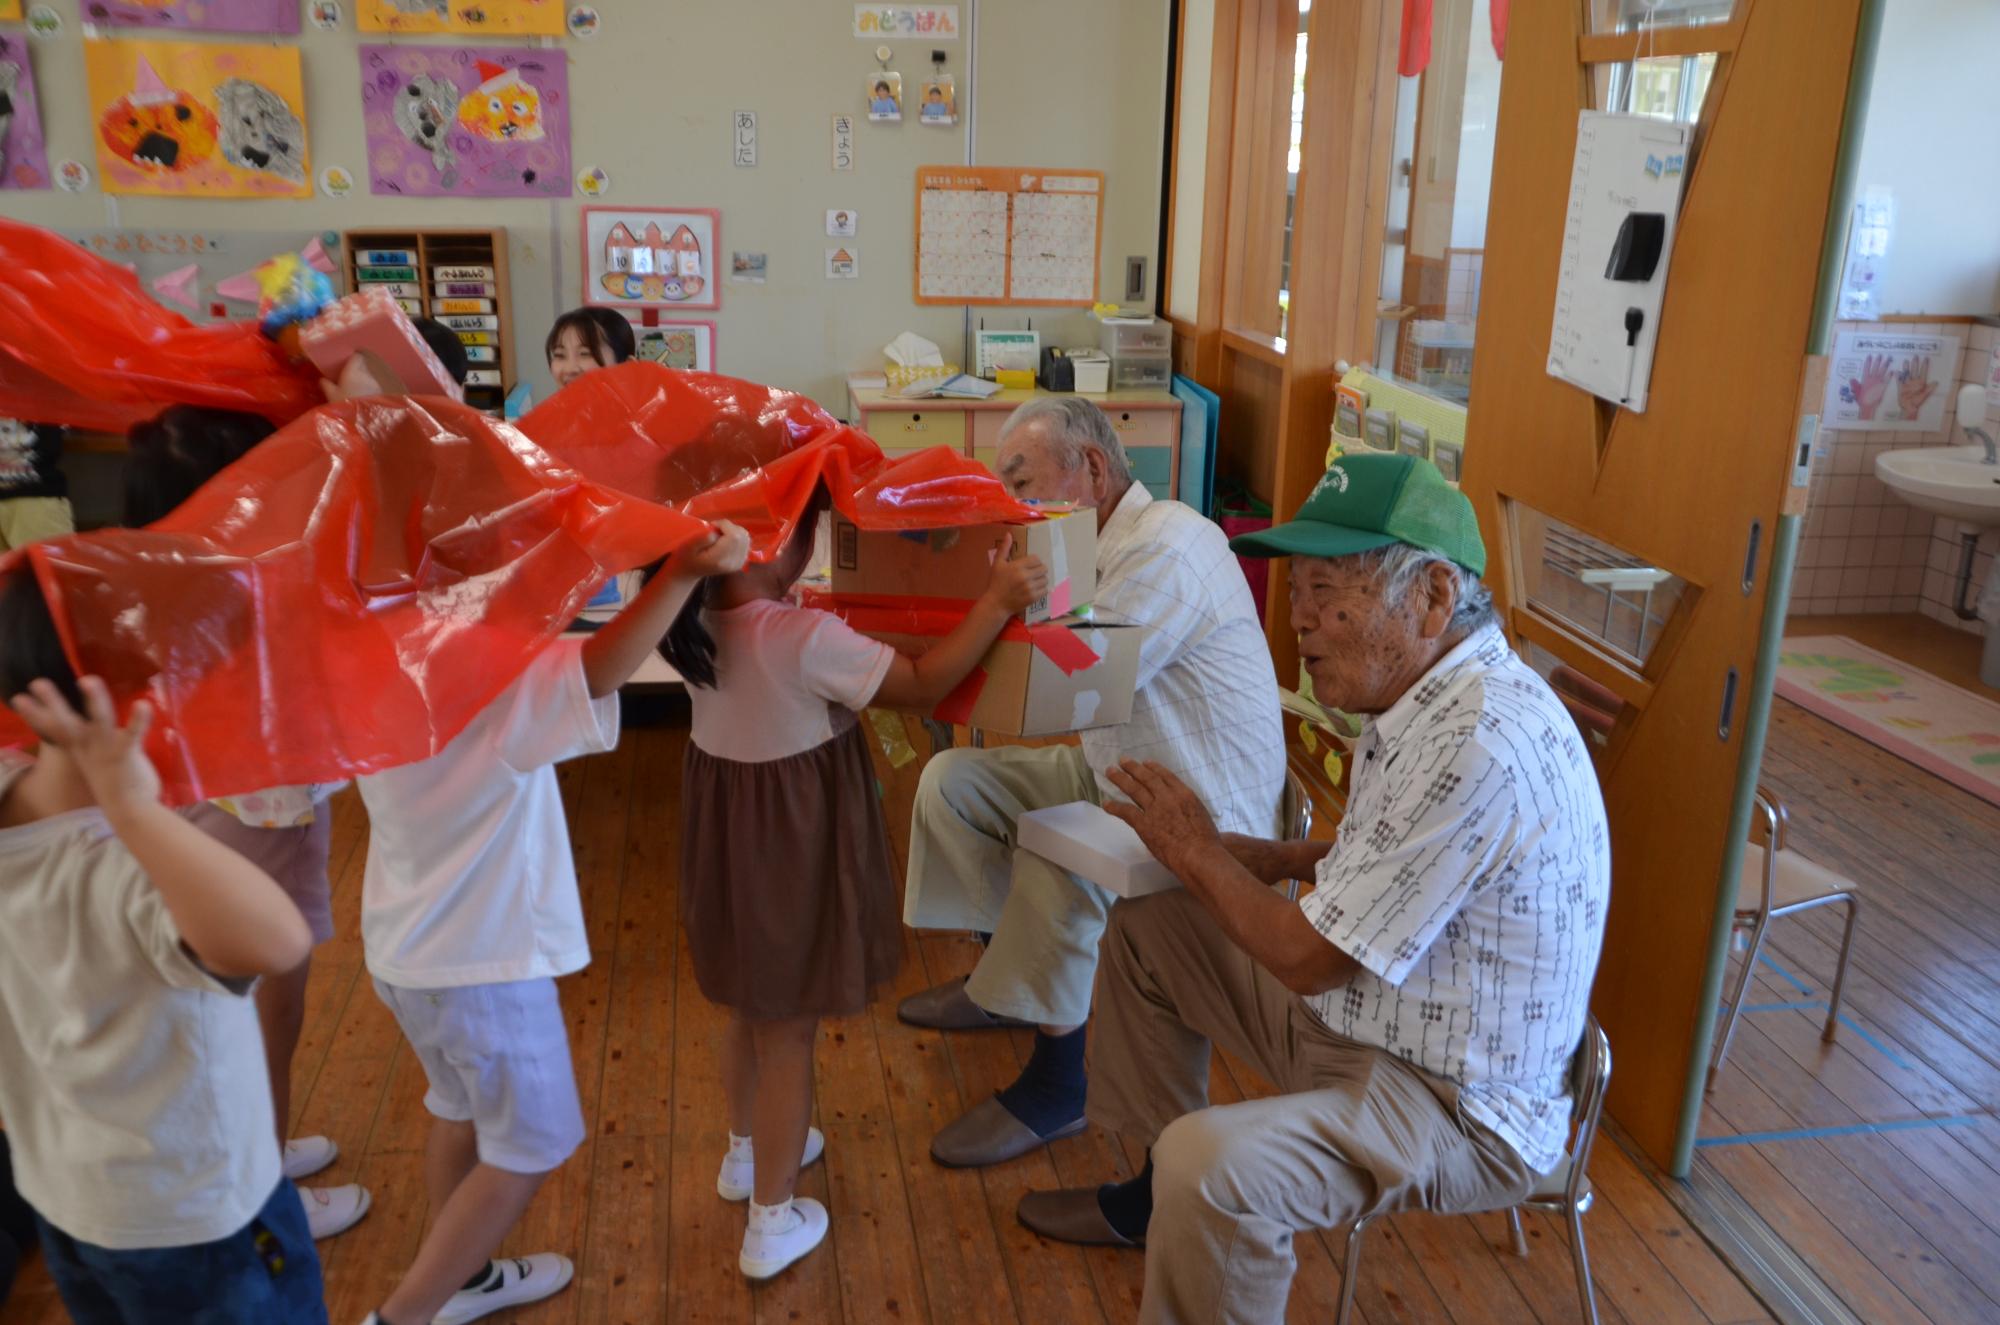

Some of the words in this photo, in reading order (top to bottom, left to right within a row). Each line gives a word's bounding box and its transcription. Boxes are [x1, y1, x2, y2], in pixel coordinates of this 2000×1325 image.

[859, 10, 956, 32] おとうばん
[737, 112, 754, 164] あした
[835, 116, 851, 168] きょう
[616, 256, 627, 268] 10
